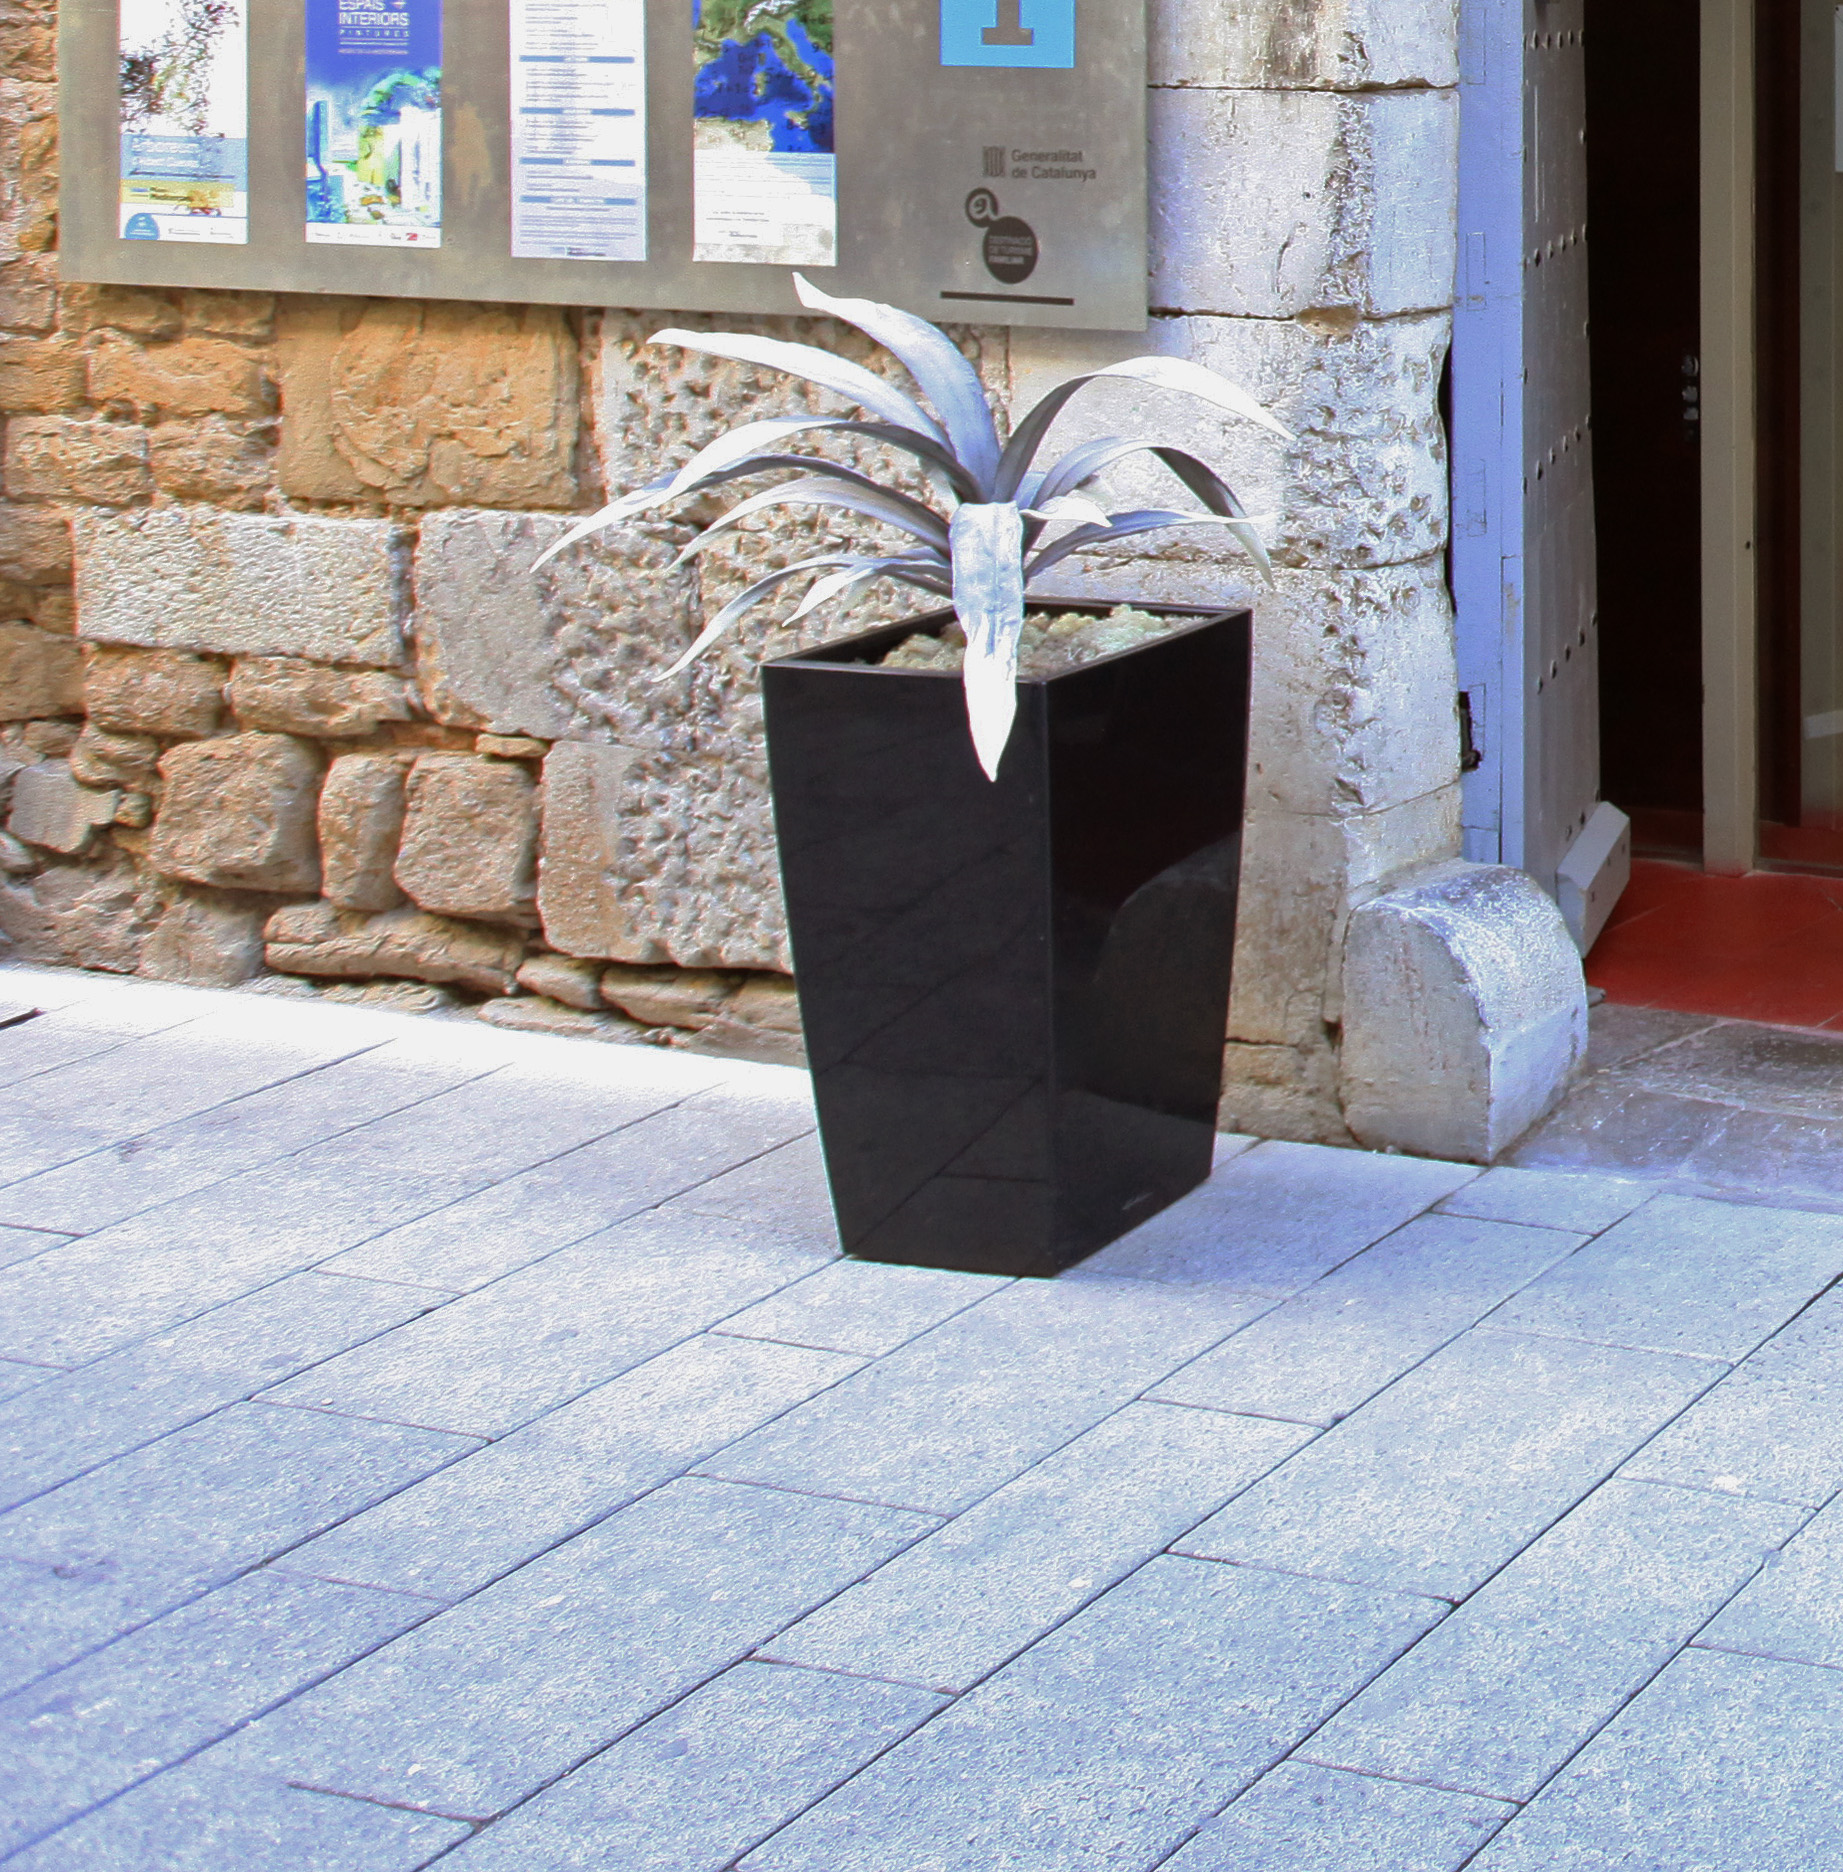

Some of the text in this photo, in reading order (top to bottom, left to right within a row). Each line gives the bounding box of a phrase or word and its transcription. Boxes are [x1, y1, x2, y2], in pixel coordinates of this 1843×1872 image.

[339, 12, 410, 26] INTERIORS
[1011, 149, 1083, 163] Generalitat
[1011, 166, 1097, 182] de Catalunya
